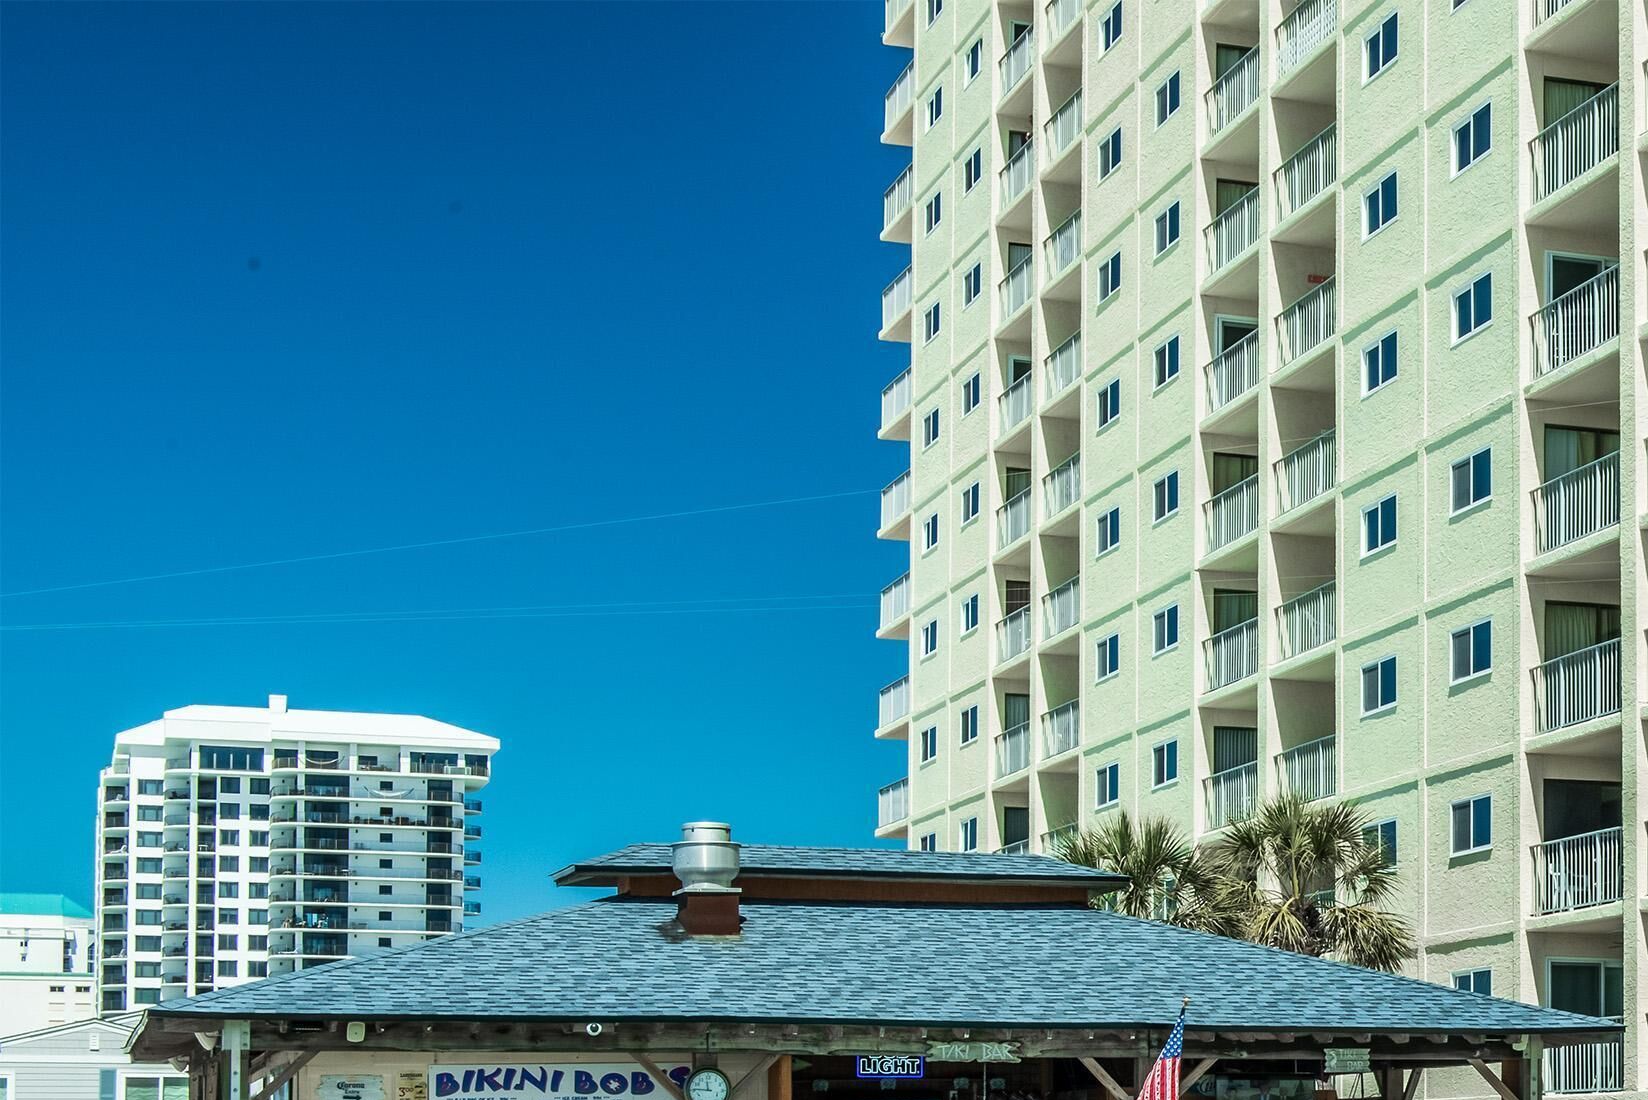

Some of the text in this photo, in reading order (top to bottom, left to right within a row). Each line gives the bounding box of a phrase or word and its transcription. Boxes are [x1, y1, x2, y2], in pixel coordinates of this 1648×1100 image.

[937, 1042, 1014, 1060] TIKI BAR
[336, 1081, 365, 1090] Corona
[436, 1066, 564, 1097] BIKINI
